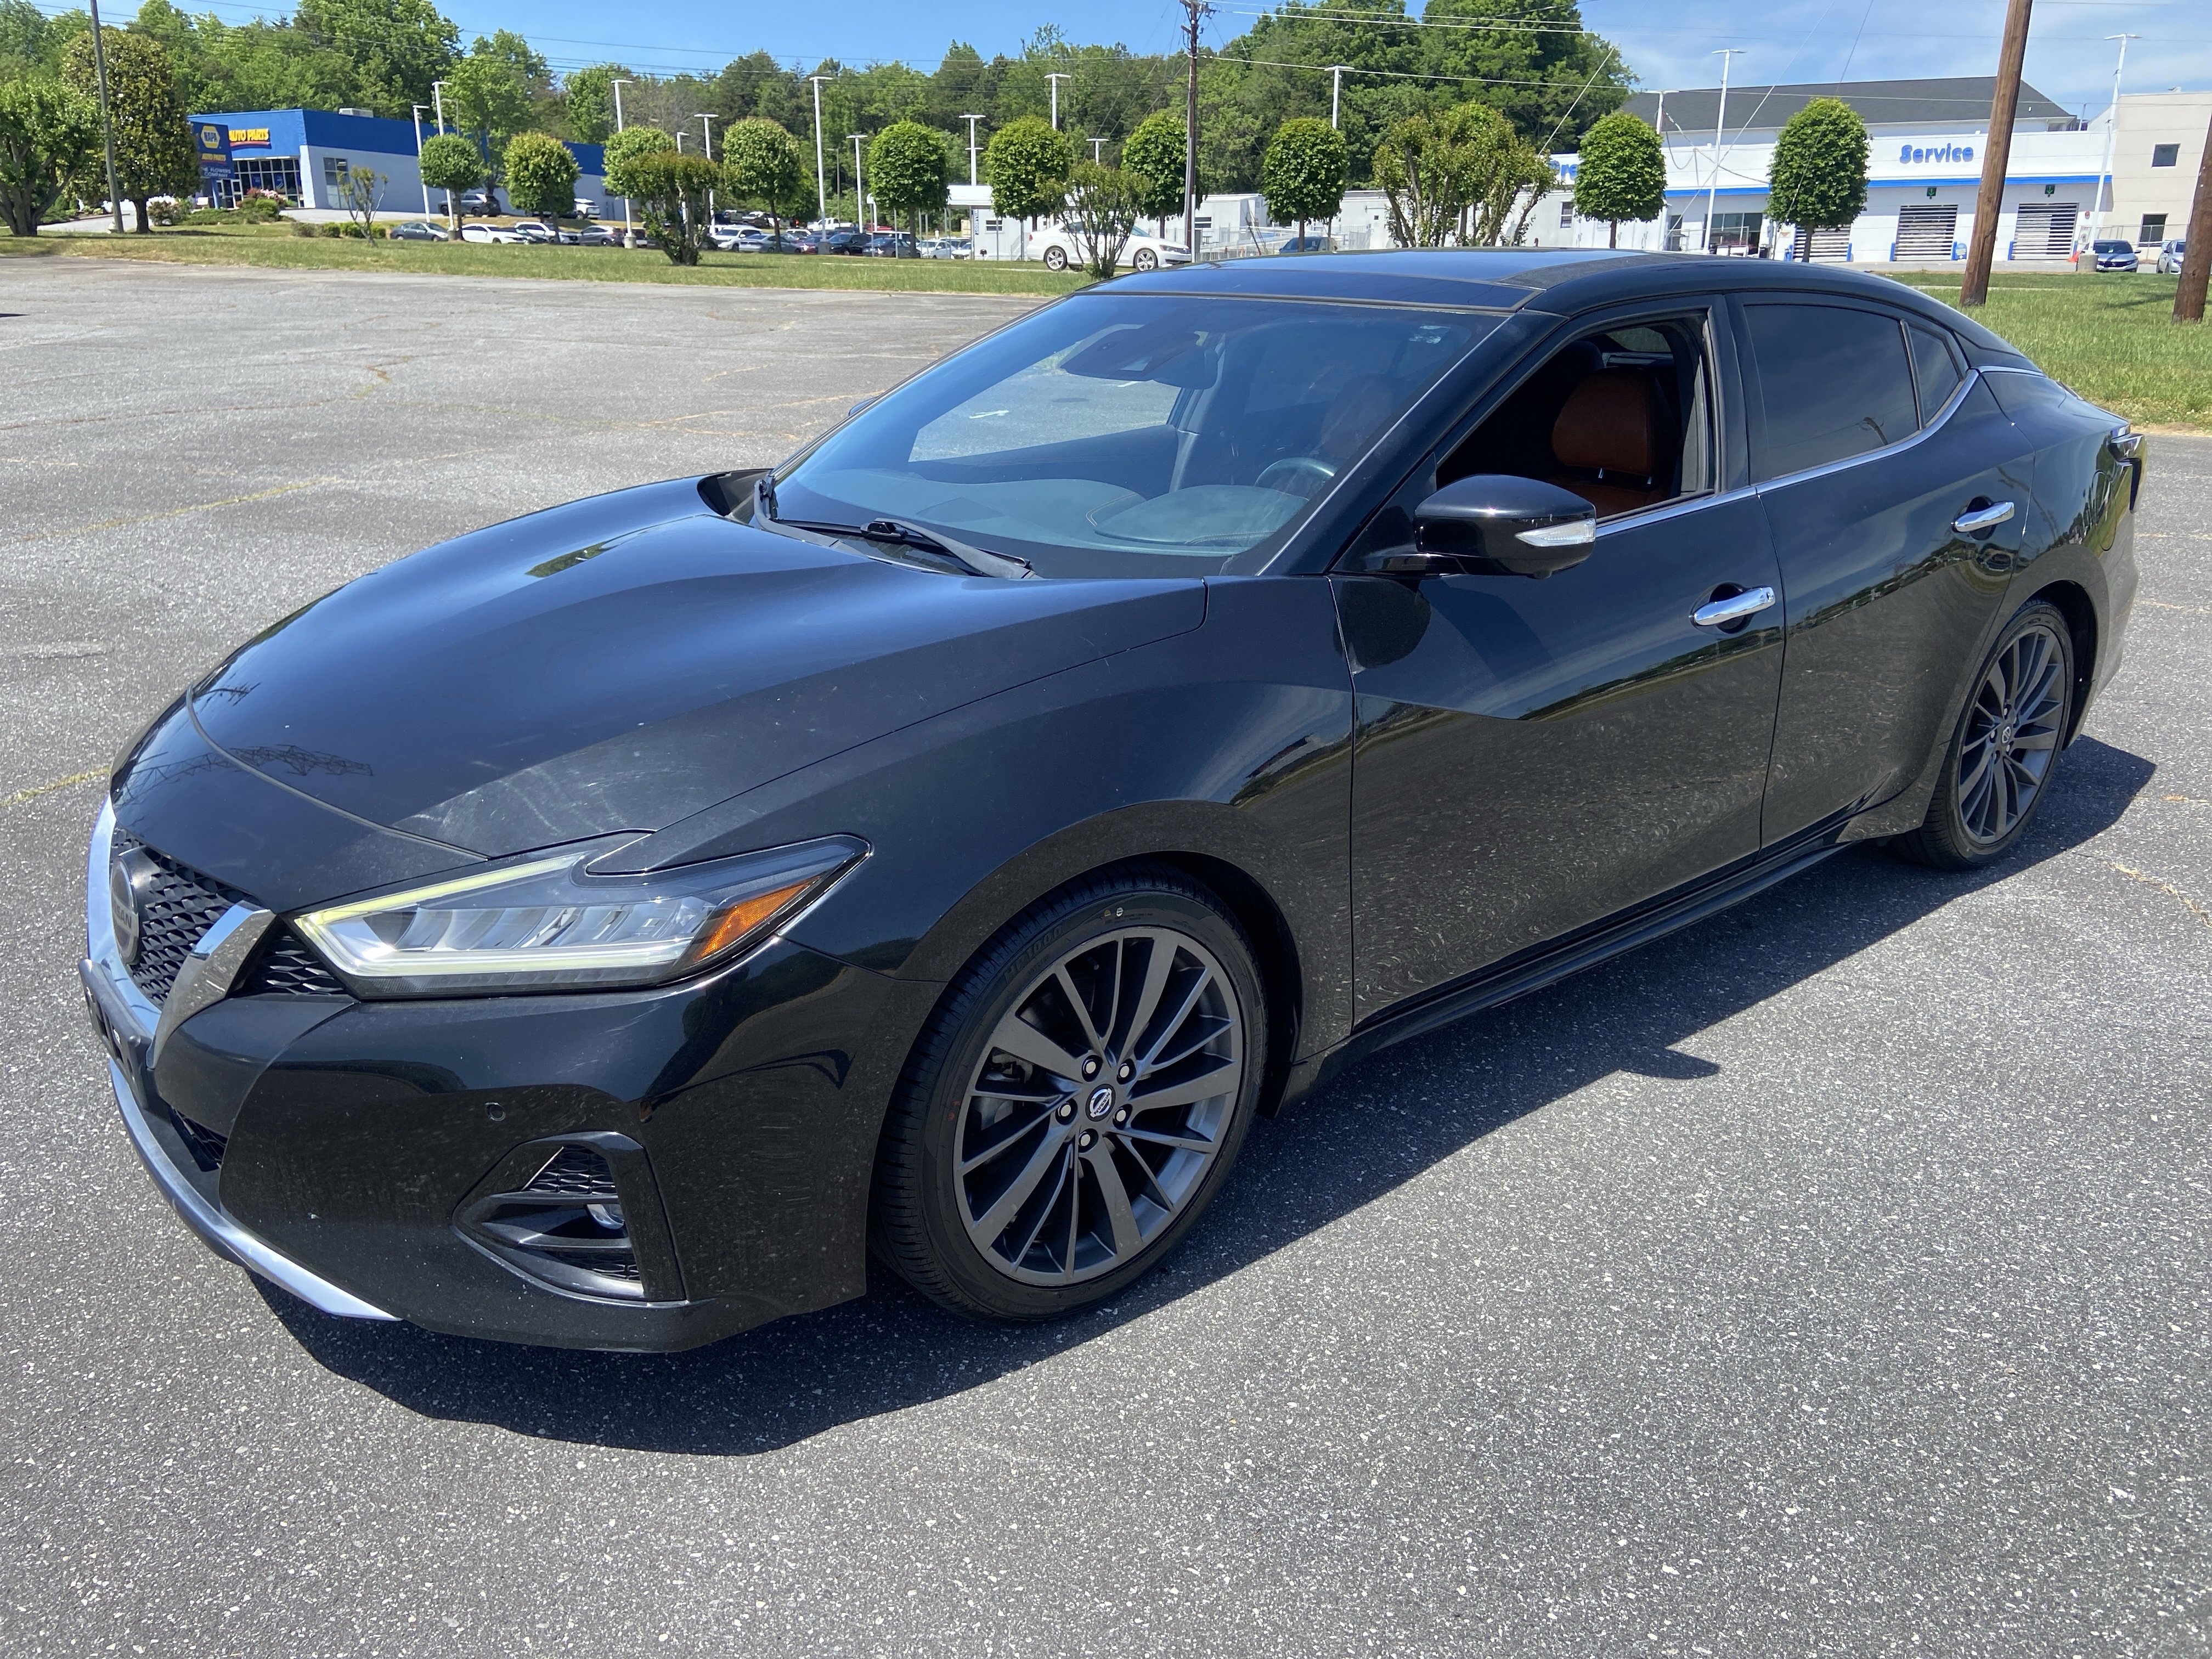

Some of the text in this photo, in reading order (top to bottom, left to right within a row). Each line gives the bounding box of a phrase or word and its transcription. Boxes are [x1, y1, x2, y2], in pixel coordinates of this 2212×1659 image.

[204, 132, 218, 142] NAPA
[247, 128, 269, 141] PARTS
[1899, 143, 1974, 164] Service
[1093, 1092, 1110, 1115] NISSAN
